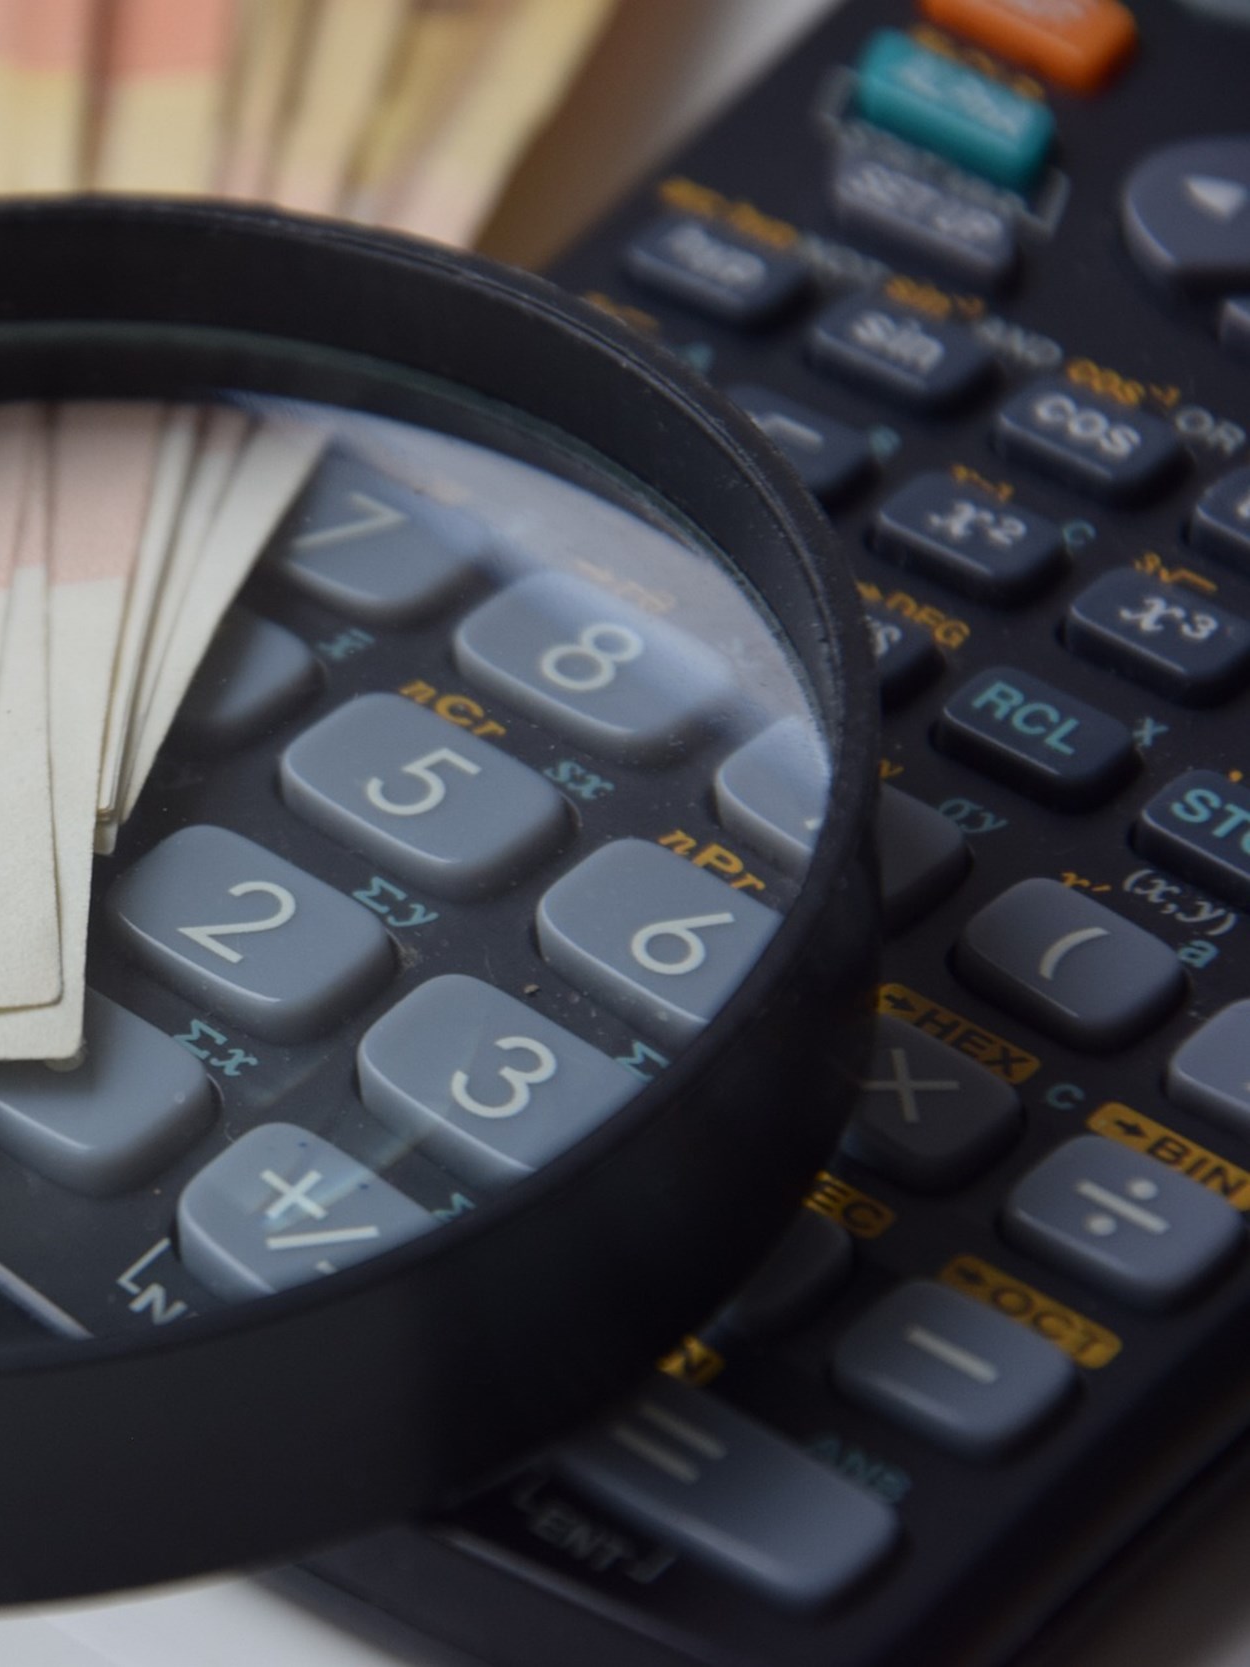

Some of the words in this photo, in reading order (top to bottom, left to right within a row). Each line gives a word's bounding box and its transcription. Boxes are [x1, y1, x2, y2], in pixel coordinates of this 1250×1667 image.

[1175, 405, 1247, 455] OR
[540, 622, 644, 692] 8
[398, 678, 507, 738] nCr
[971, 680, 1082, 756] RCL
[365, 747, 482, 817] 5
[657, 828, 766, 896] nPr
[176, 880, 297, 965] 2
[630, 911, 736, 977] 6
[450, 1035, 557, 1119] 3
[914, 1008, 1028, 1077] HEX
[1147, 1135, 1249, 1198] BIN
